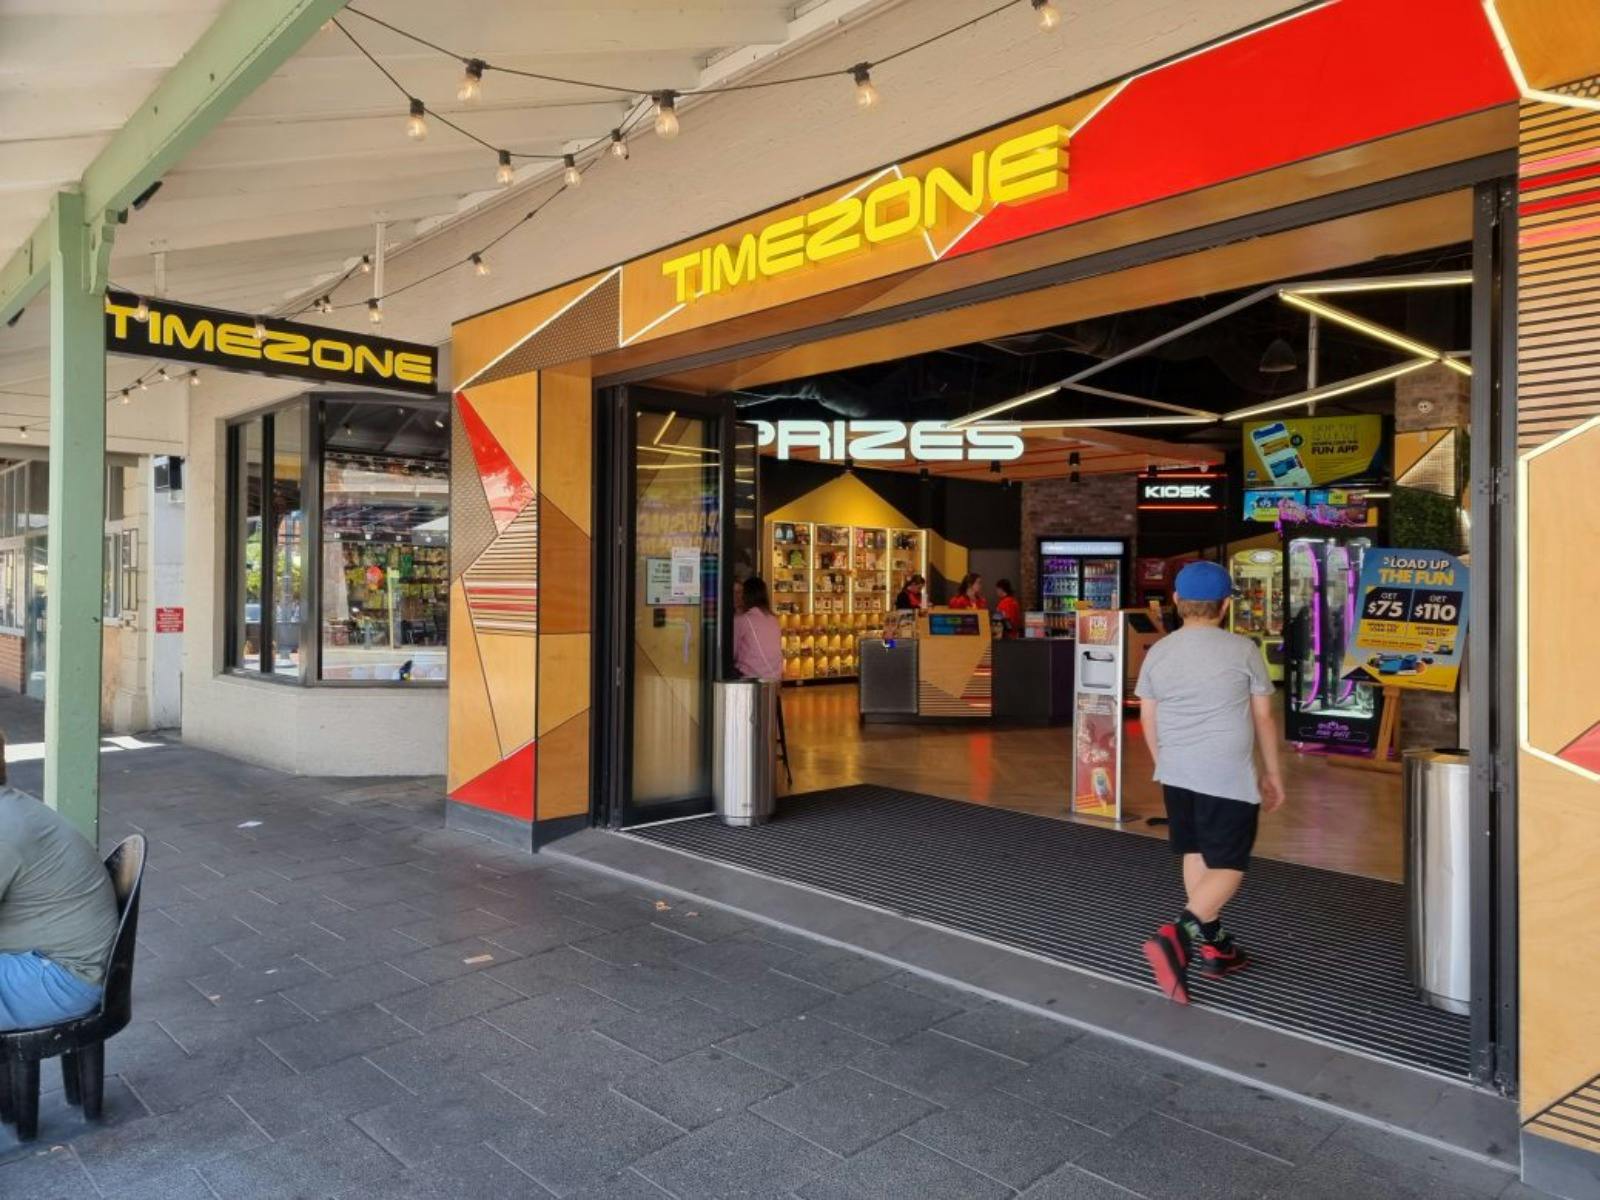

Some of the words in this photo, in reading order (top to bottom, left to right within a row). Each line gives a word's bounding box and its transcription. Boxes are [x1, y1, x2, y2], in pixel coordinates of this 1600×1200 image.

[662, 124, 1069, 302] TIMEZONE
[105, 303, 433, 384] TIMEZONE
[1312, 446, 1334, 455] FUN
[1337, 445, 1359, 453] APP
[1145, 485, 1211, 498] KIOSK
[1390, 558, 1427, 569] LOAD
[1430, 560, 1449, 570] UP
[1379, 569, 1412, 584] THE
[1416, 571, 1454, 586] FUN
[1381, 592, 1397, 600] GET
[1368, 601, 1403, 617] $75
[1415, 603, 1456, 620] $110
